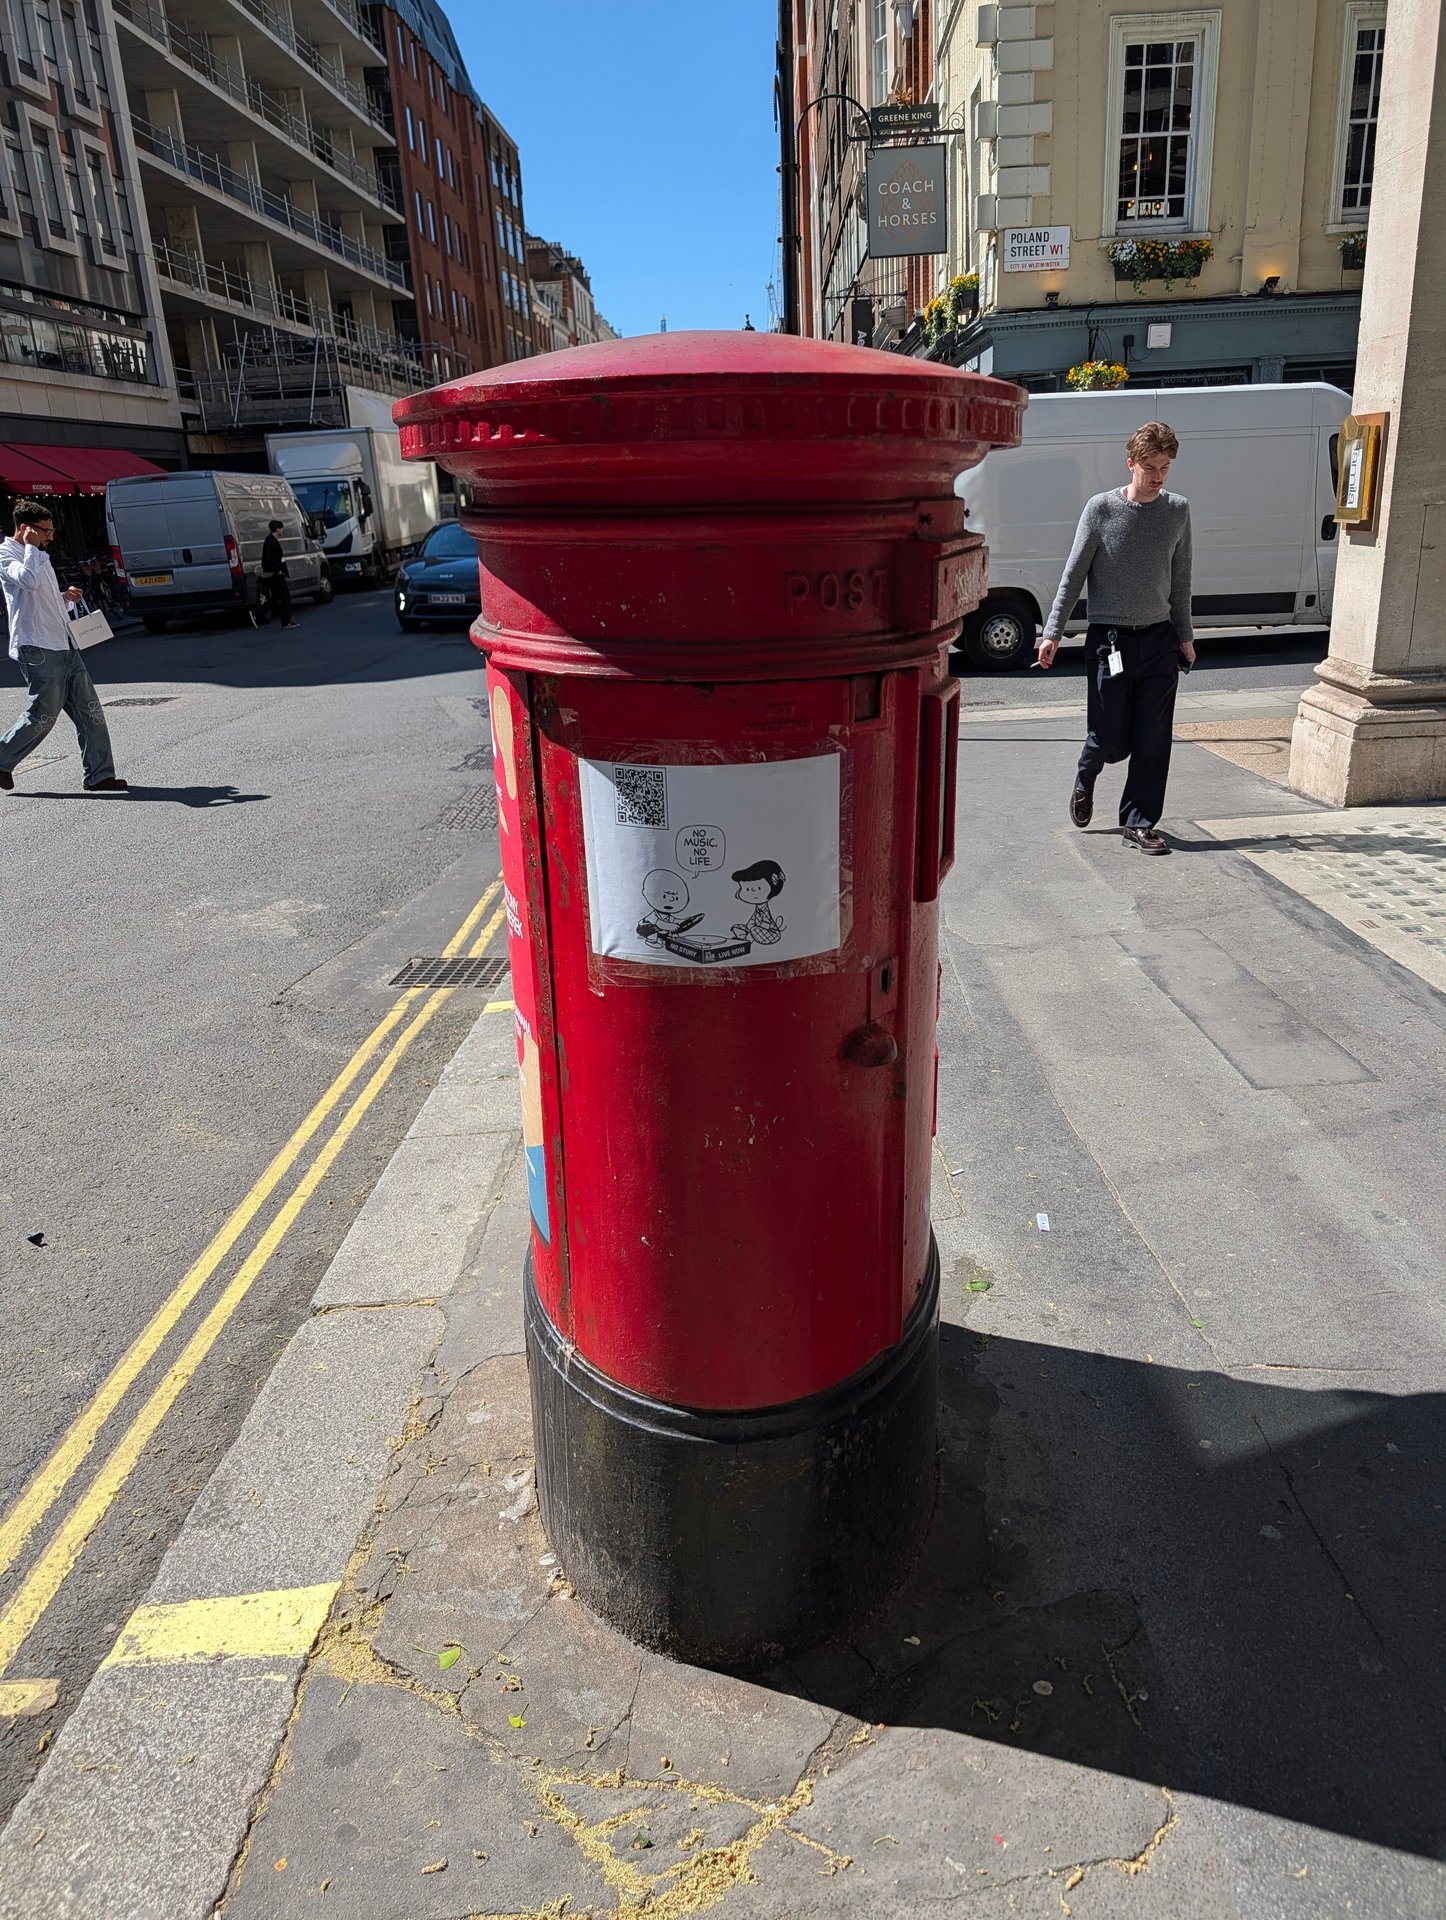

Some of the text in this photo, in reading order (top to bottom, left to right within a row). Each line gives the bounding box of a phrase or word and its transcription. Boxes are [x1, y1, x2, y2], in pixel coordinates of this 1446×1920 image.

[878, 112, 932, 122] GREENE KING
[878, 179, 934, 195] COACH
[901, 197, 912, 210] &
[878, 211, 937, 228] HORSES
[1010, 231, 1050, 244] POLAND
[1010, 244, 1063, 257] STREET W1
[783, 568, 888, 617] POST
[692, 829, 707, 838] NO
[684, 837, 718, 848] MUSIC,
[693, 848, 707, 856] NO
[689, 856, 713, 867] LIFE.
[679, 946, 698, 957] STORY
[717, 949, 731, 958] LIVE
[731, 946, 745, 955] NOW
